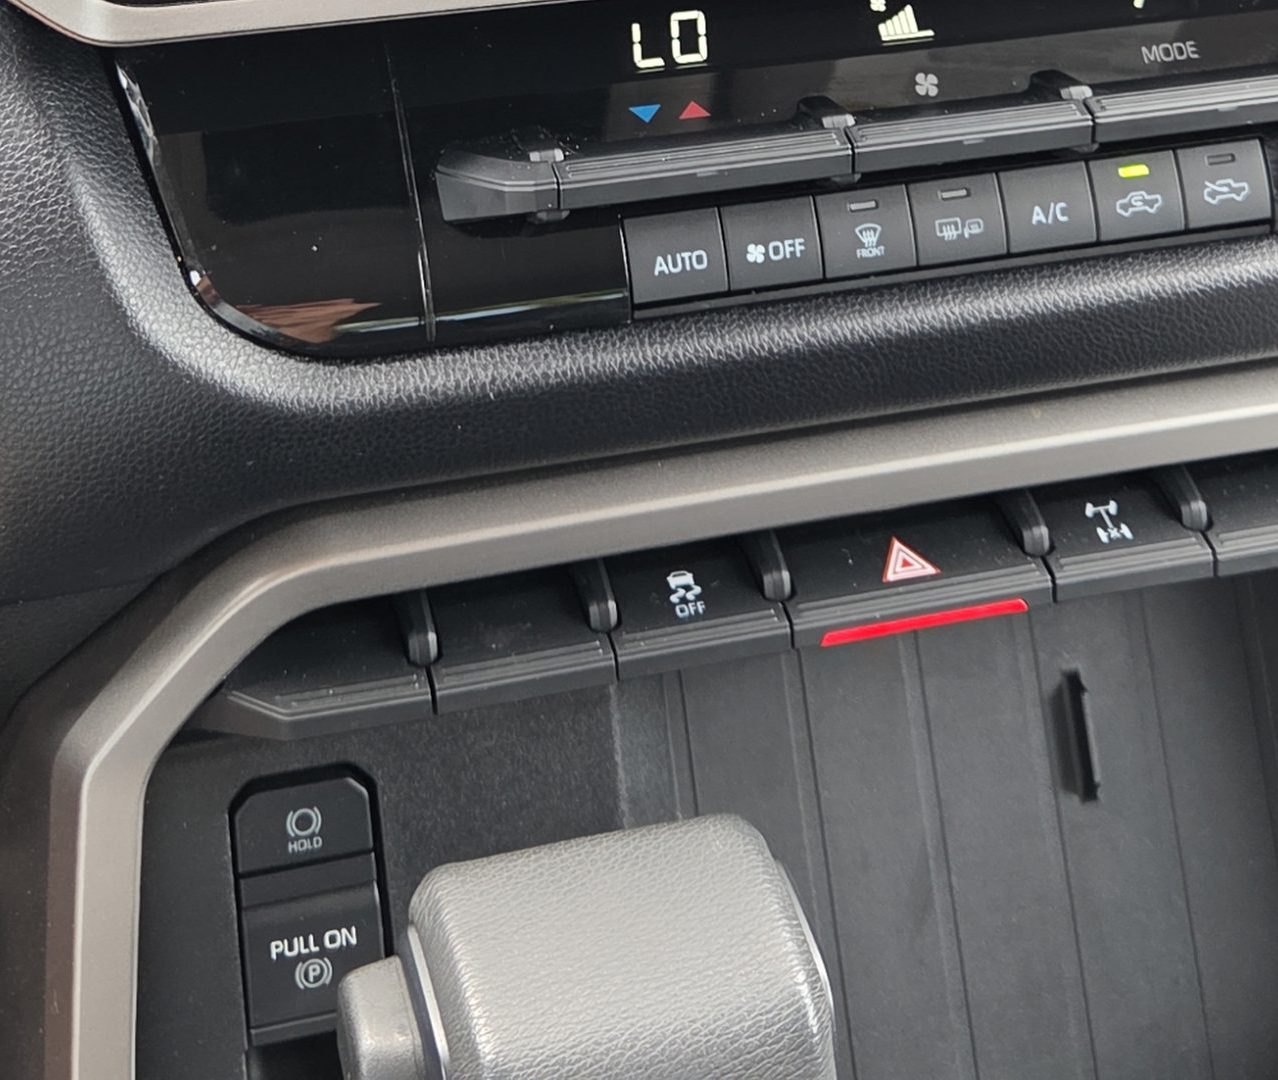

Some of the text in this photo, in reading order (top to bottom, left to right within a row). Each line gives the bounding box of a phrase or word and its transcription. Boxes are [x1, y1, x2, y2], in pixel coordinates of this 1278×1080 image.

[1140, 39, 1202, 65] MODE
[1031, 201, 1070, 226] A/C
[768, 237, 806, 262] OFF
[856, 244, 885, 260] FRONT
[653, 248, 709, 277] AUTO
[675, 600, 707, 619] OFF
[287, 835, 323, 854] HOLD
[270, 925, 358, 961] PULL ON
